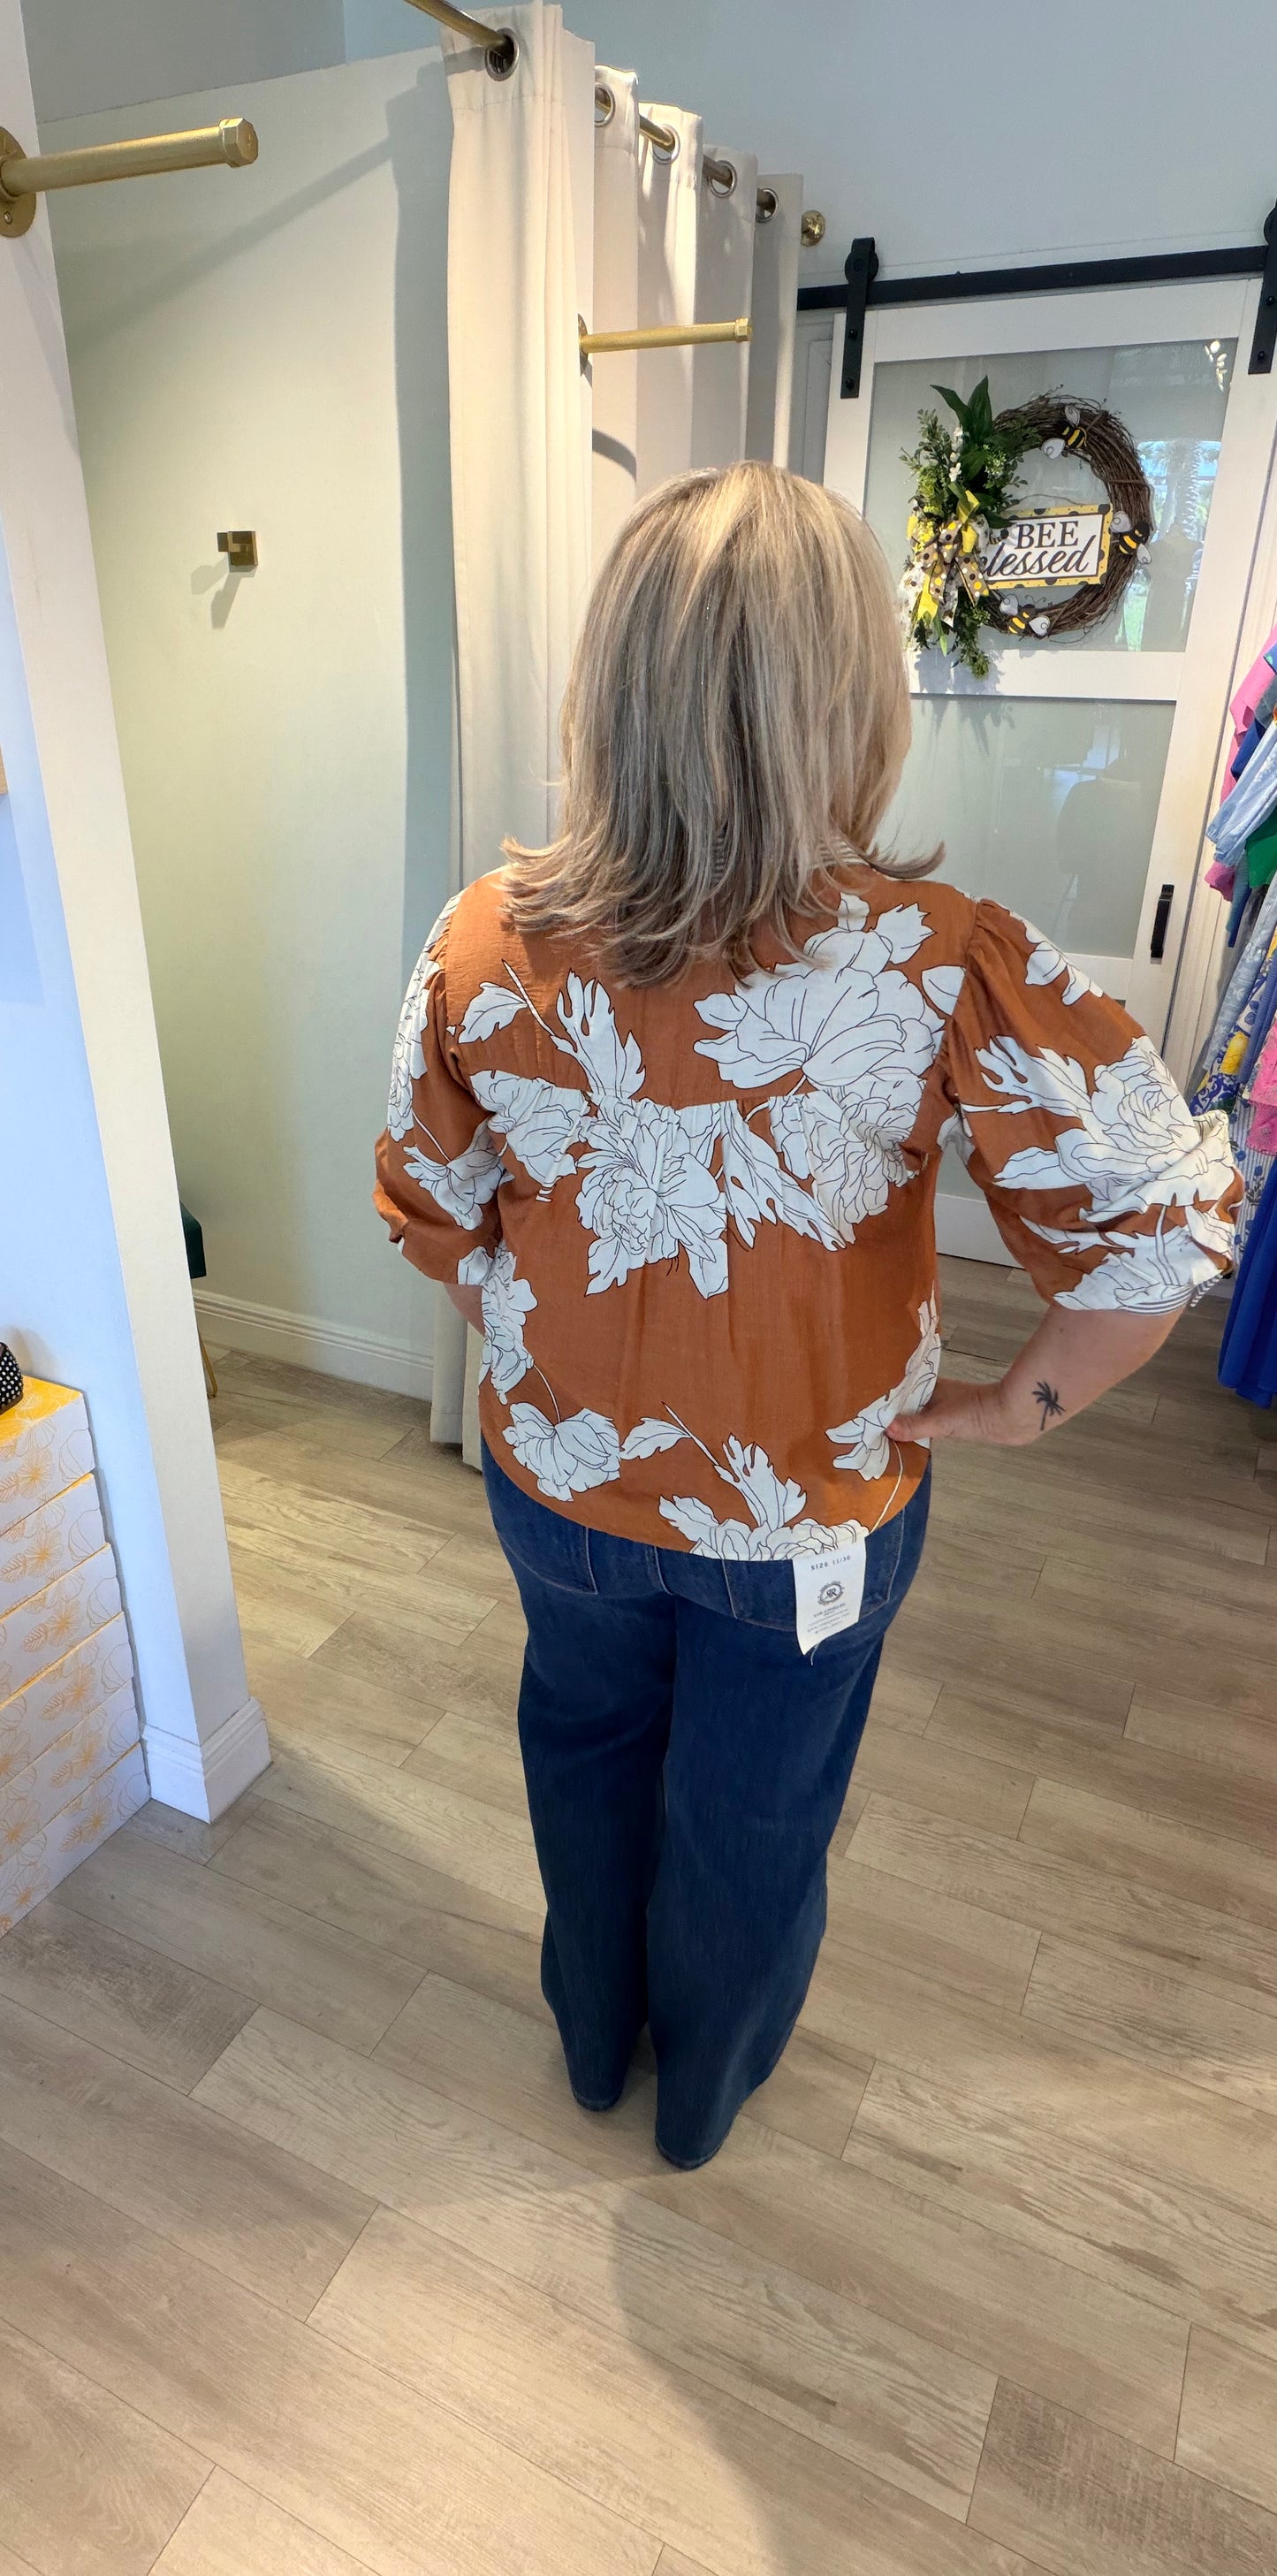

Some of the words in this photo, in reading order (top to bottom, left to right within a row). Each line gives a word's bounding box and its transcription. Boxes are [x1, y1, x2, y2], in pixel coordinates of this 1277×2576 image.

[1014, 521, 1079, 550] BEE
[982, 534, 1097, 577] lessed
[810, 1562, 829, 1571] SIZE
